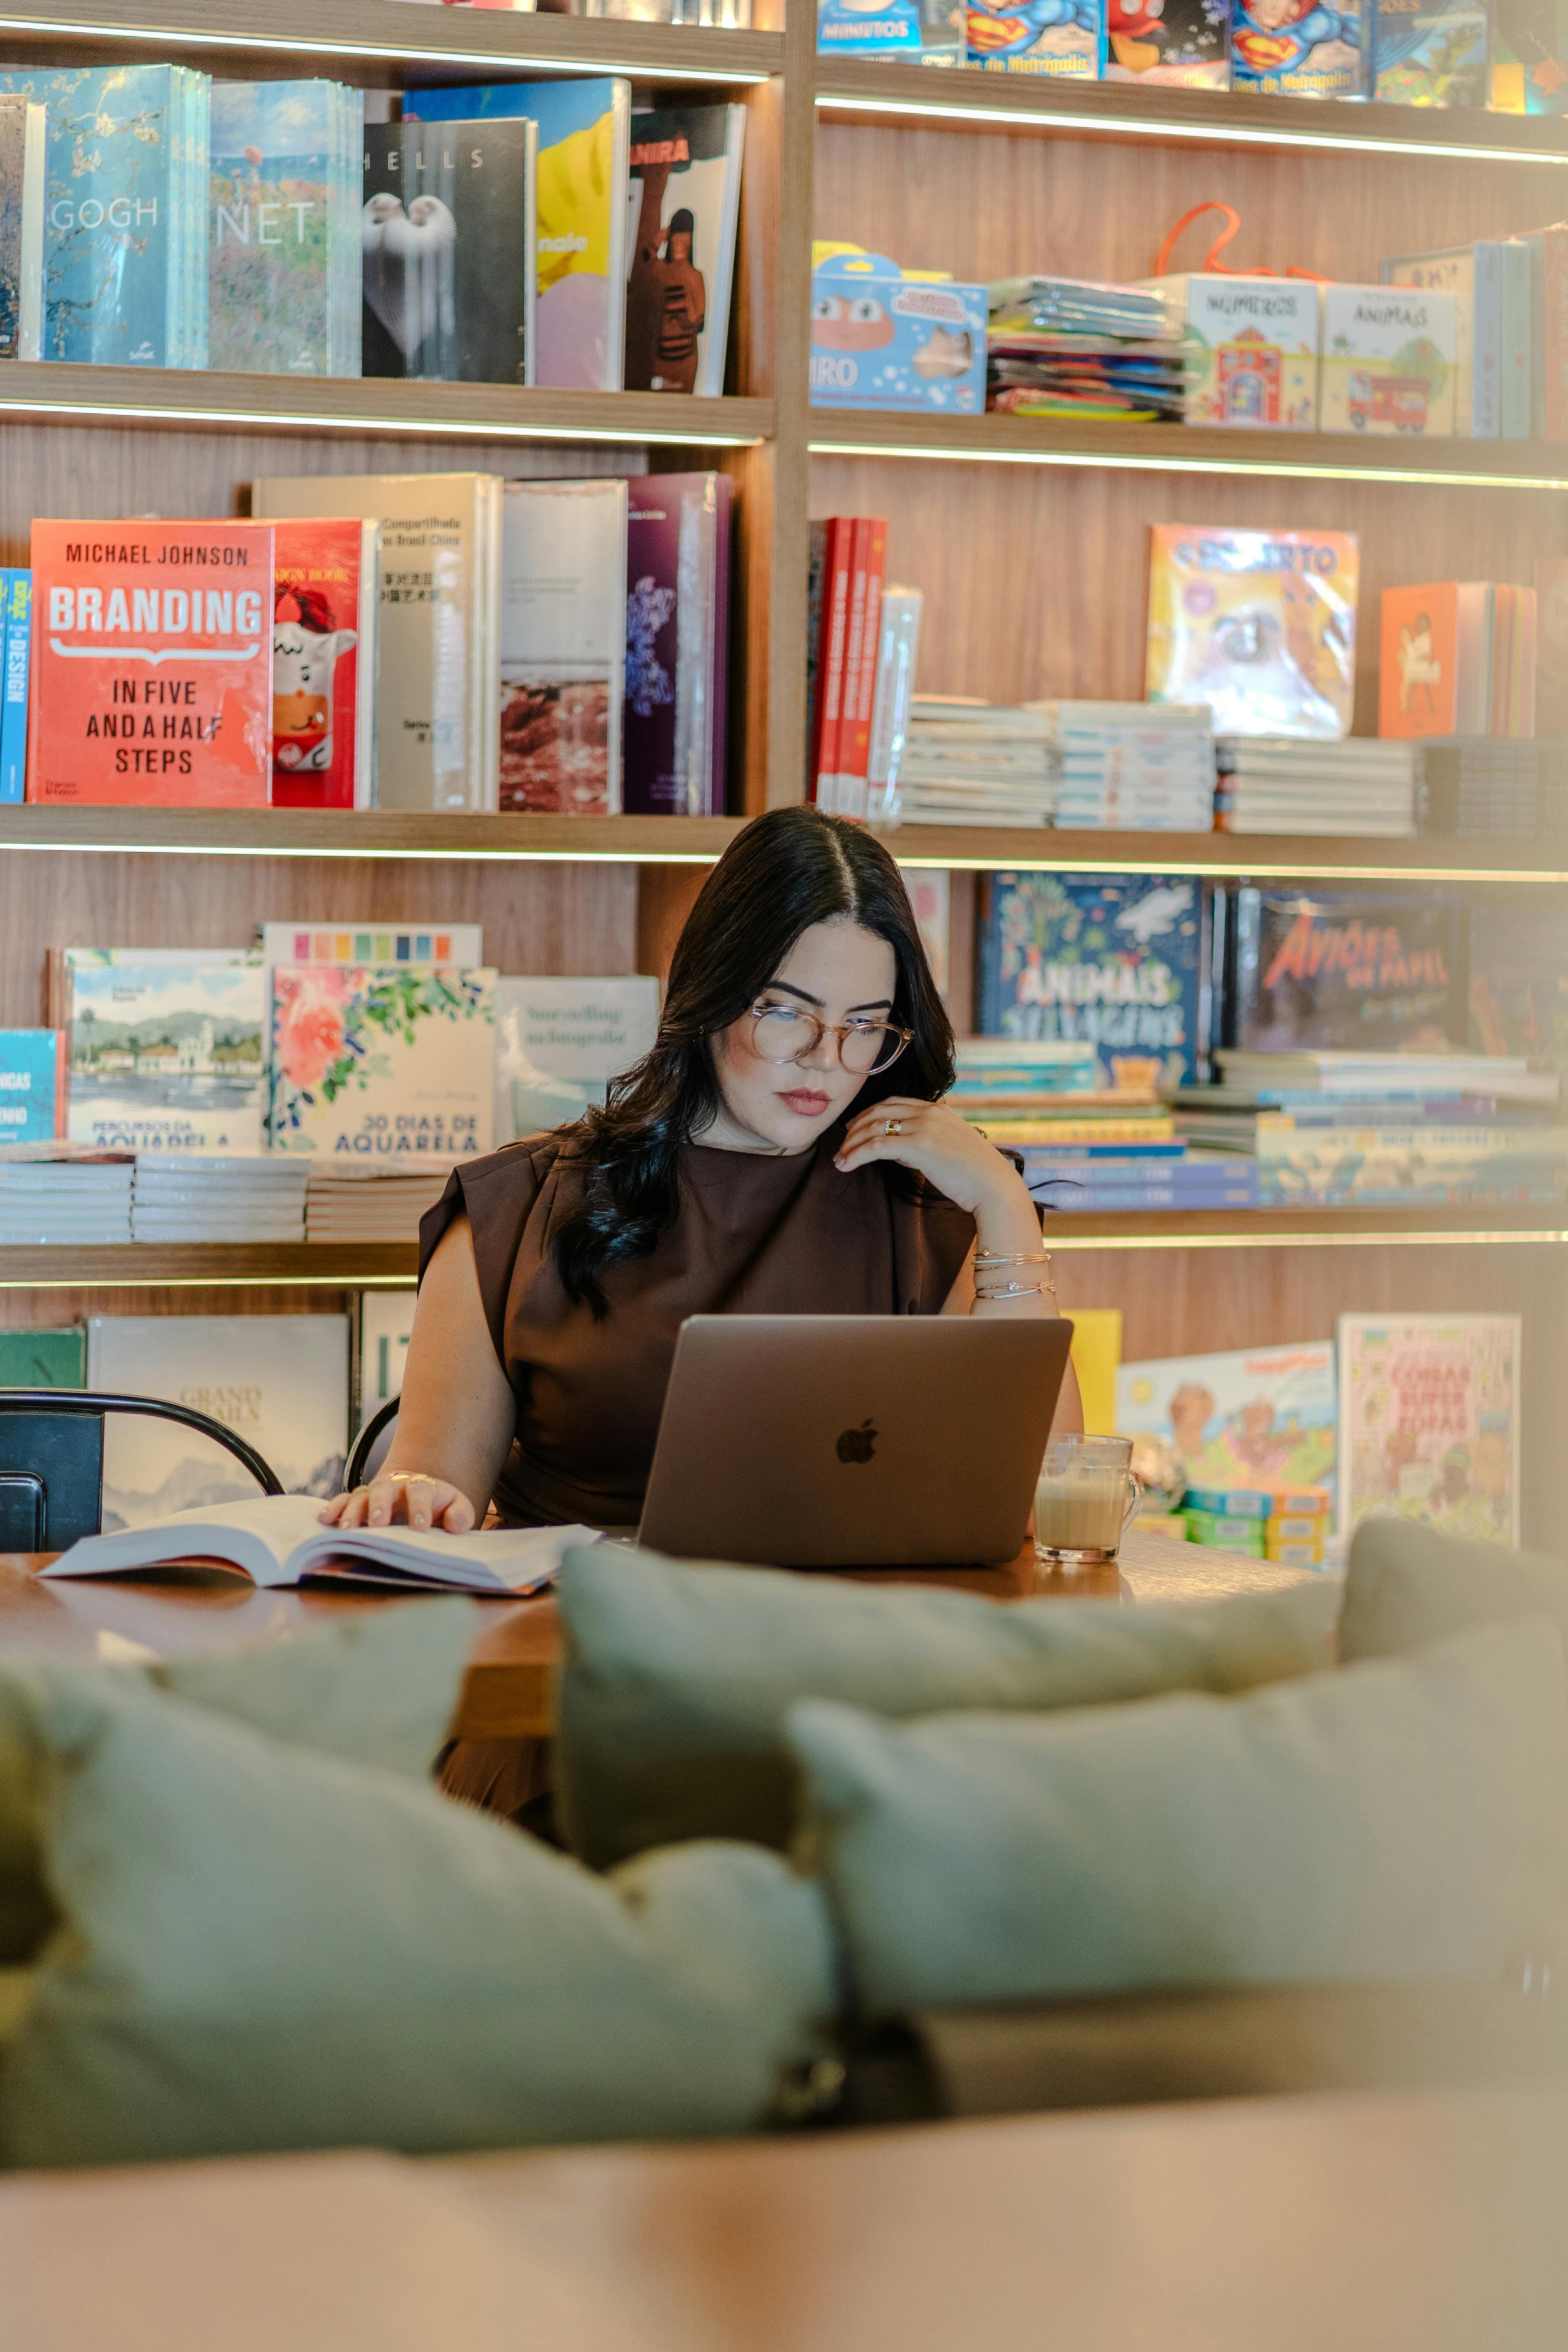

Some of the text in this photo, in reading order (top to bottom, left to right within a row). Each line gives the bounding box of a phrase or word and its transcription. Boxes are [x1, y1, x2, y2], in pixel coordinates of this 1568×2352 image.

[51, 197, 158, 230] GOGH
[216, 202, 316, 246] NET
[396, 534, 427, 546] Brasil
[66, 544, 249, 566] MICHAEL JOHNSON
[50, 586, 262, 635] BRANDING
[7, 639, 27, 703] DESIGN
[113, 680, 196, 705] IN FIVE
[86, 715, 223, 740] AND A HALF
[116, 749, 192, 774] STEPS
[363, 1114, 478, 1132] 30 DIAS DE
[335, 1135, 479, 1153] AQUARELA
